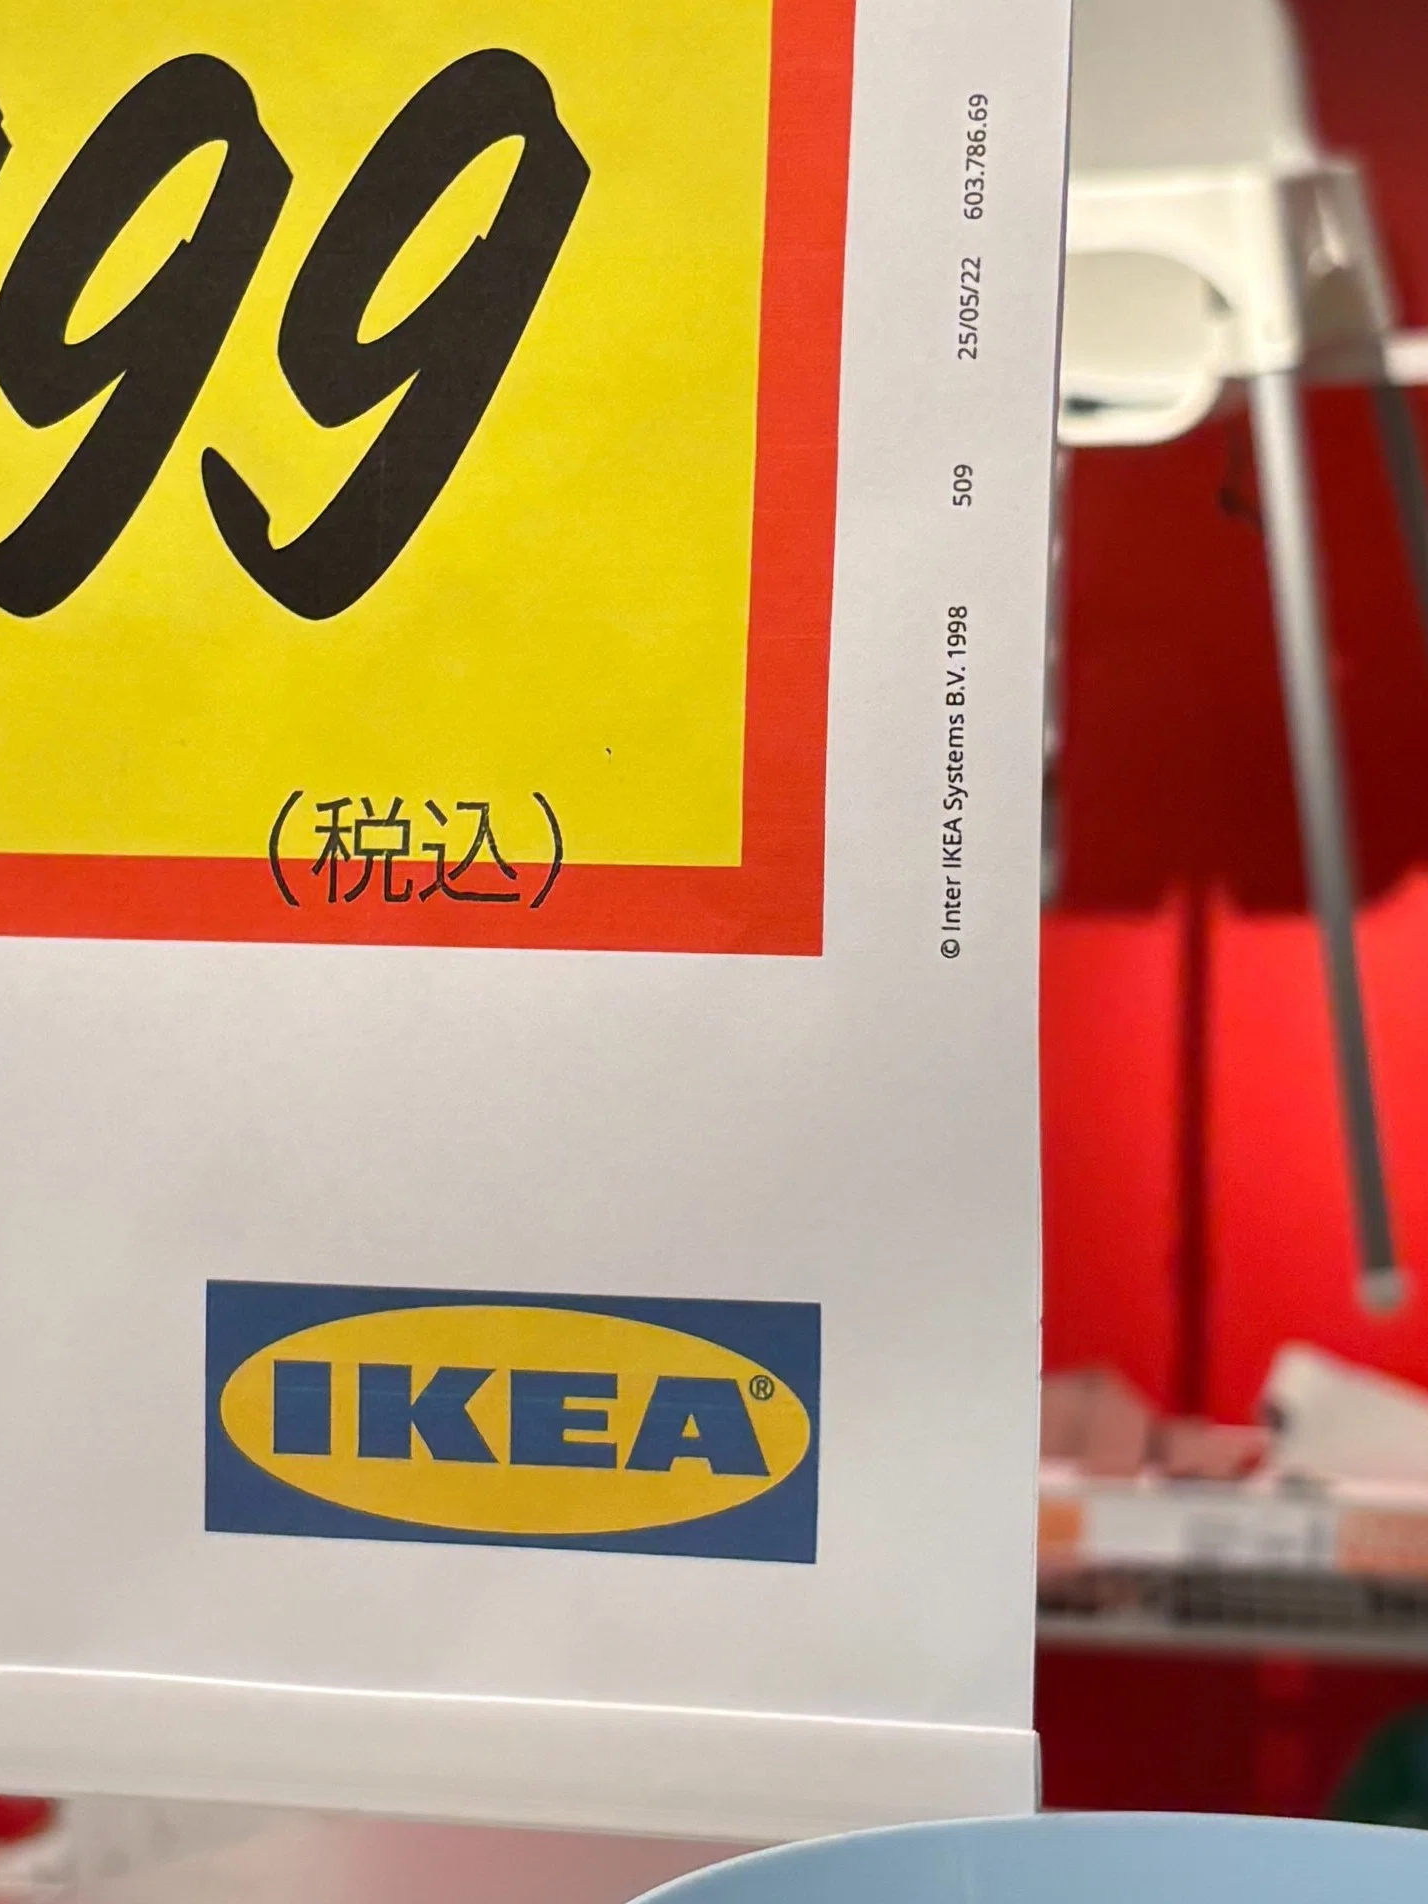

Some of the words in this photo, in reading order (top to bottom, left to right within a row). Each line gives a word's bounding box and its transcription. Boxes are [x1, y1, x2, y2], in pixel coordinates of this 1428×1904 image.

[963, 93, 989, 220] 603.786.69
[957, 257, 982, 360] 25/05/22
[952, 463, 974, 507] 509
[947, 605, 968, 658] 1998
[945, 666, 967, 708] B.V.
[943, 713, 969, 811] Systems
[942, 816, 964, 869] IKEA
[941, 876, 962, 932] Inter
